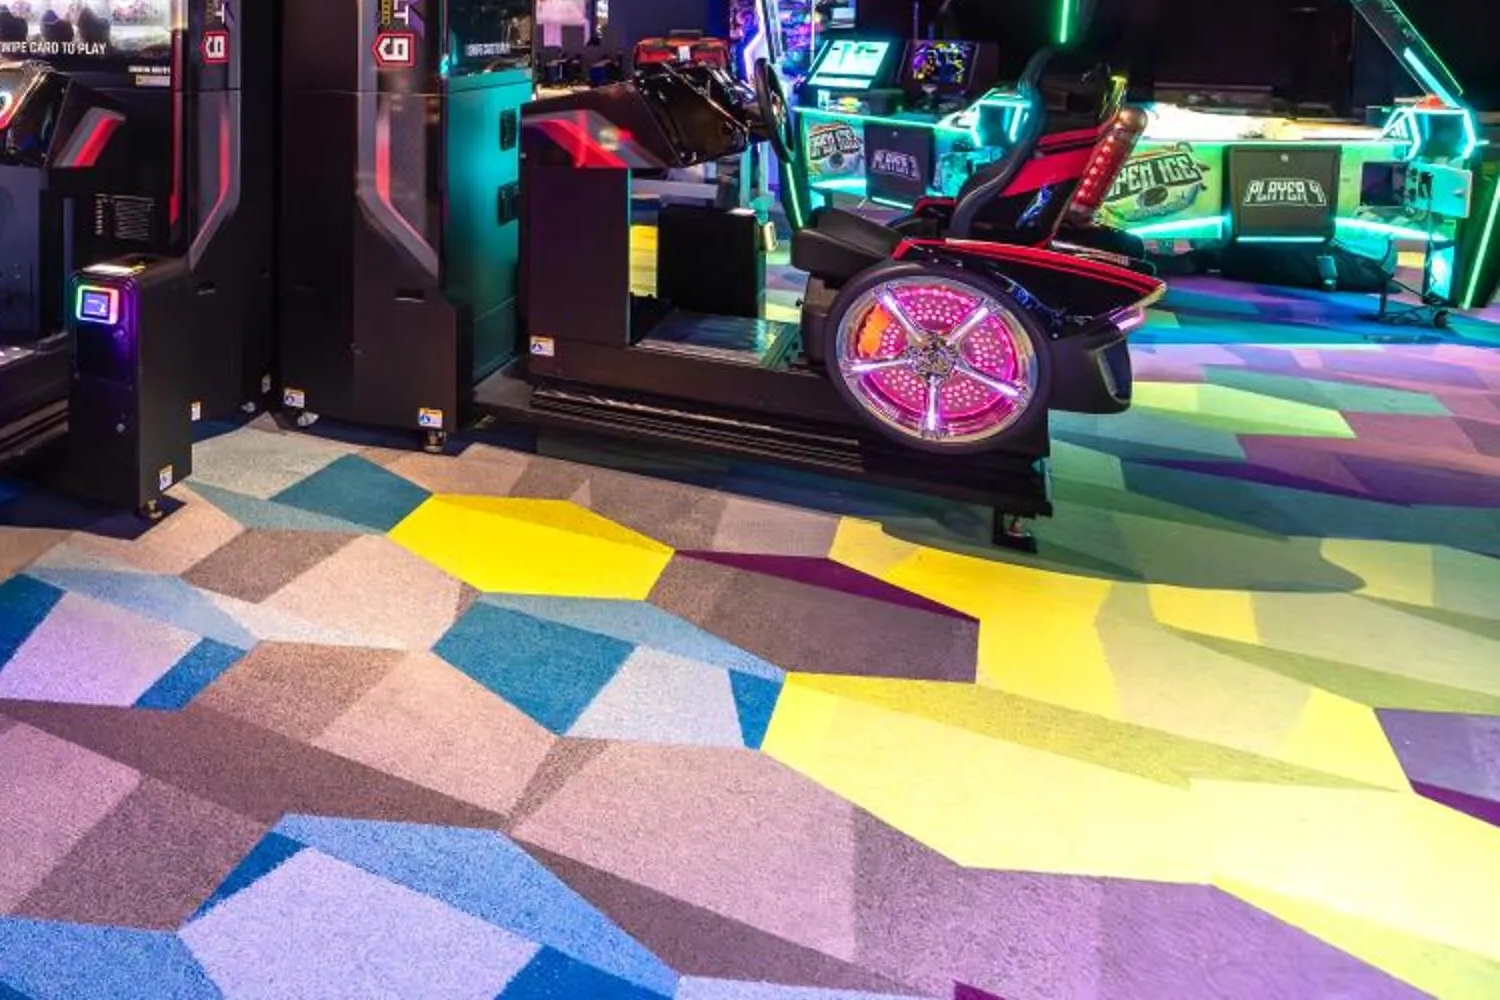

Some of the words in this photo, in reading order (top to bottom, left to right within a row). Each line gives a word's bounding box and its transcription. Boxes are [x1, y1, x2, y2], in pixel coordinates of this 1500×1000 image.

[30, 41, 59, 54] CARD
[62, 42, 75, 54] TO
[77, 42, 107, 55] PLAY
[1158, 156, 1197, 185] ICE
[1246, 181, 1307, 202] PLAYER
